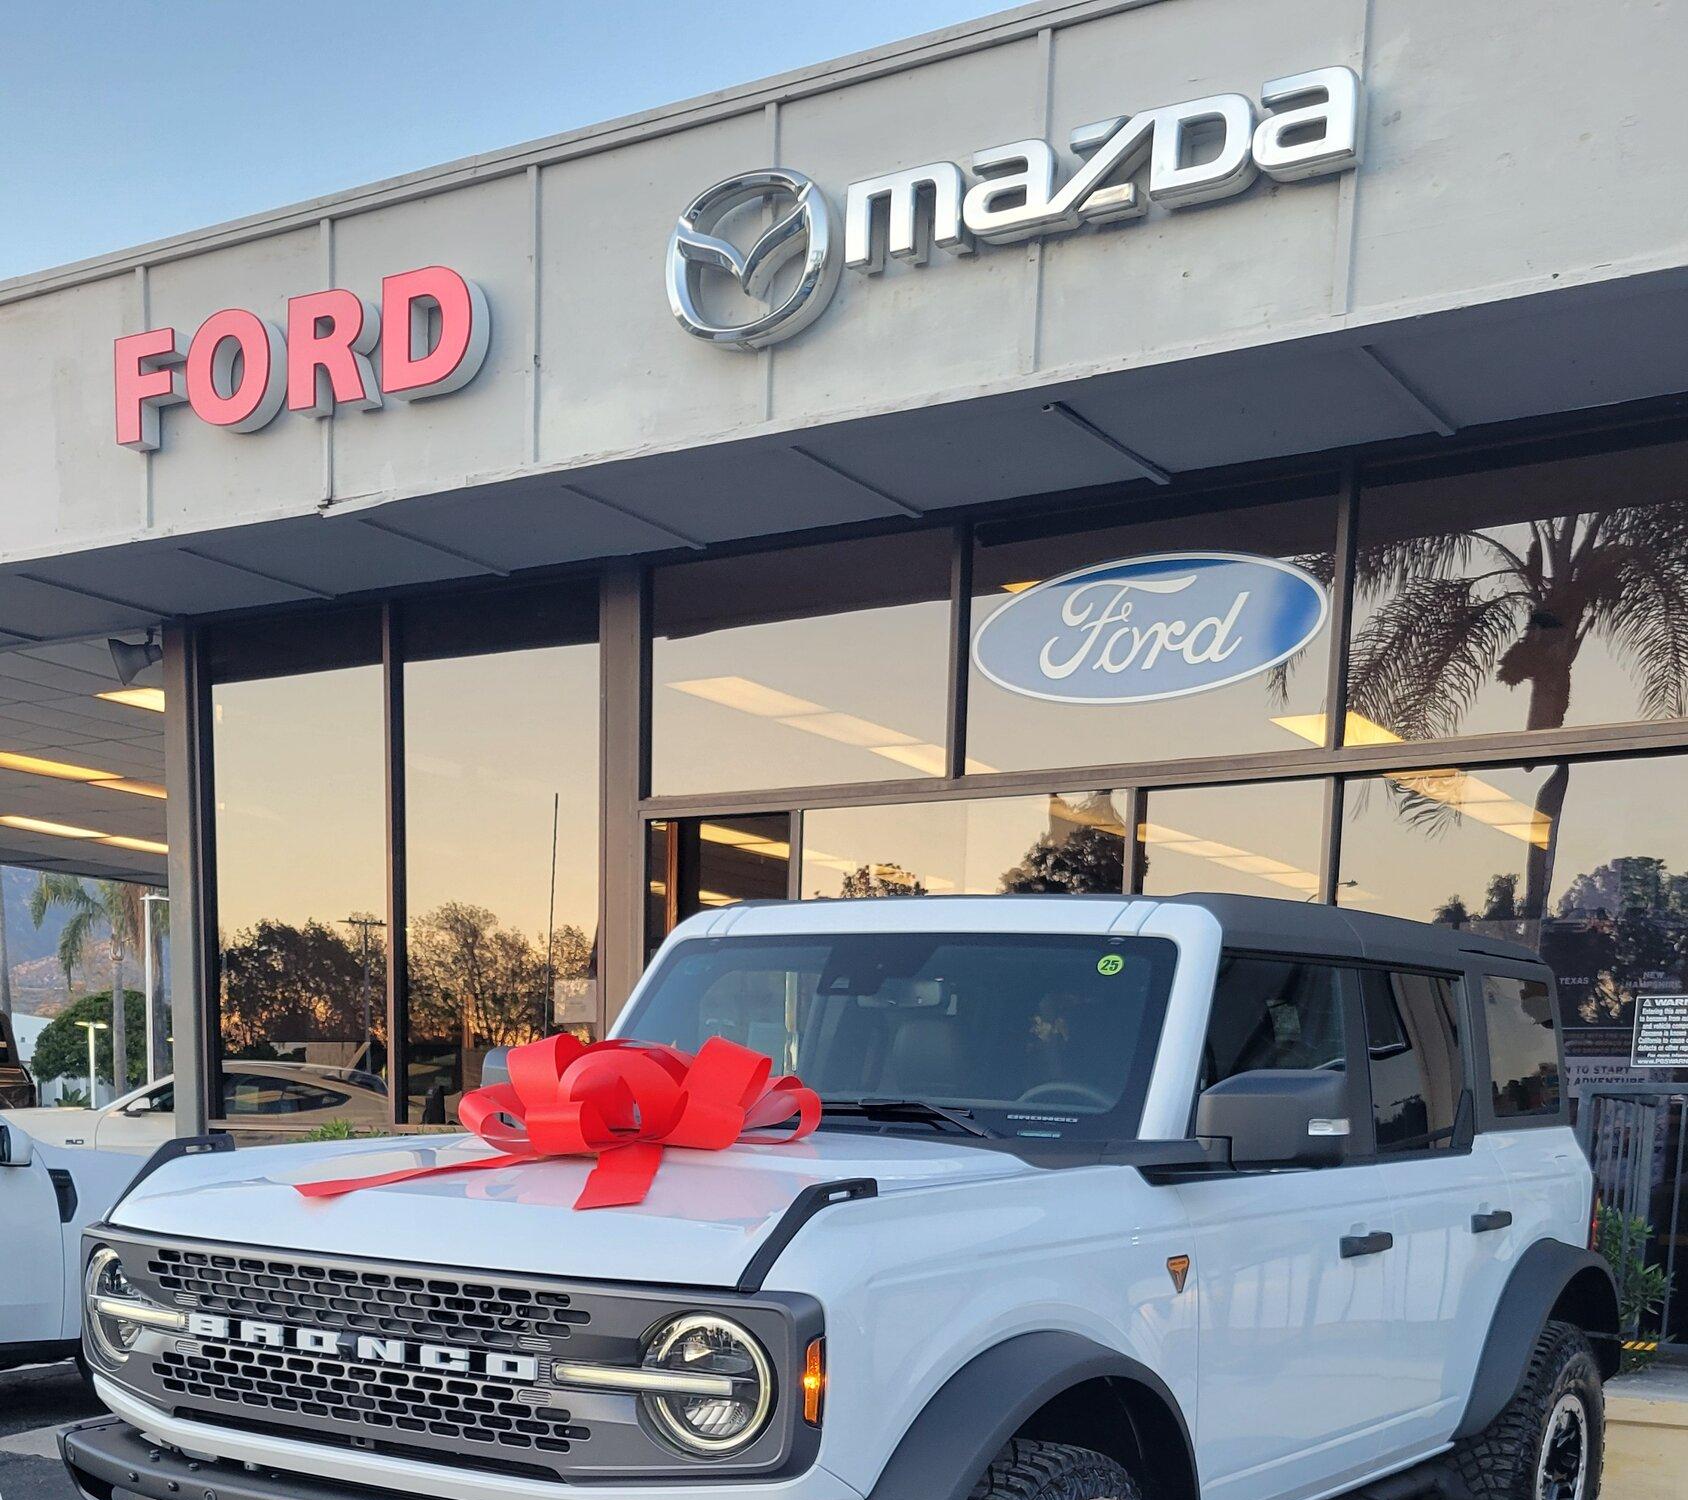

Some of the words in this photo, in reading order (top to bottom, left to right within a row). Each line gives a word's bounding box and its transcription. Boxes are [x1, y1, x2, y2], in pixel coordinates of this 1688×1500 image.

[114, 266, 488, 450] FORD
[1039, 574, 1250, 680] Ford
[1100, 960, 1120, 971] 25
[1560, 977, 1588, 985] TEXAS
[1593, 1066, 1629, 1075] START
[188, 1312, 538, 1382] BRONCO
